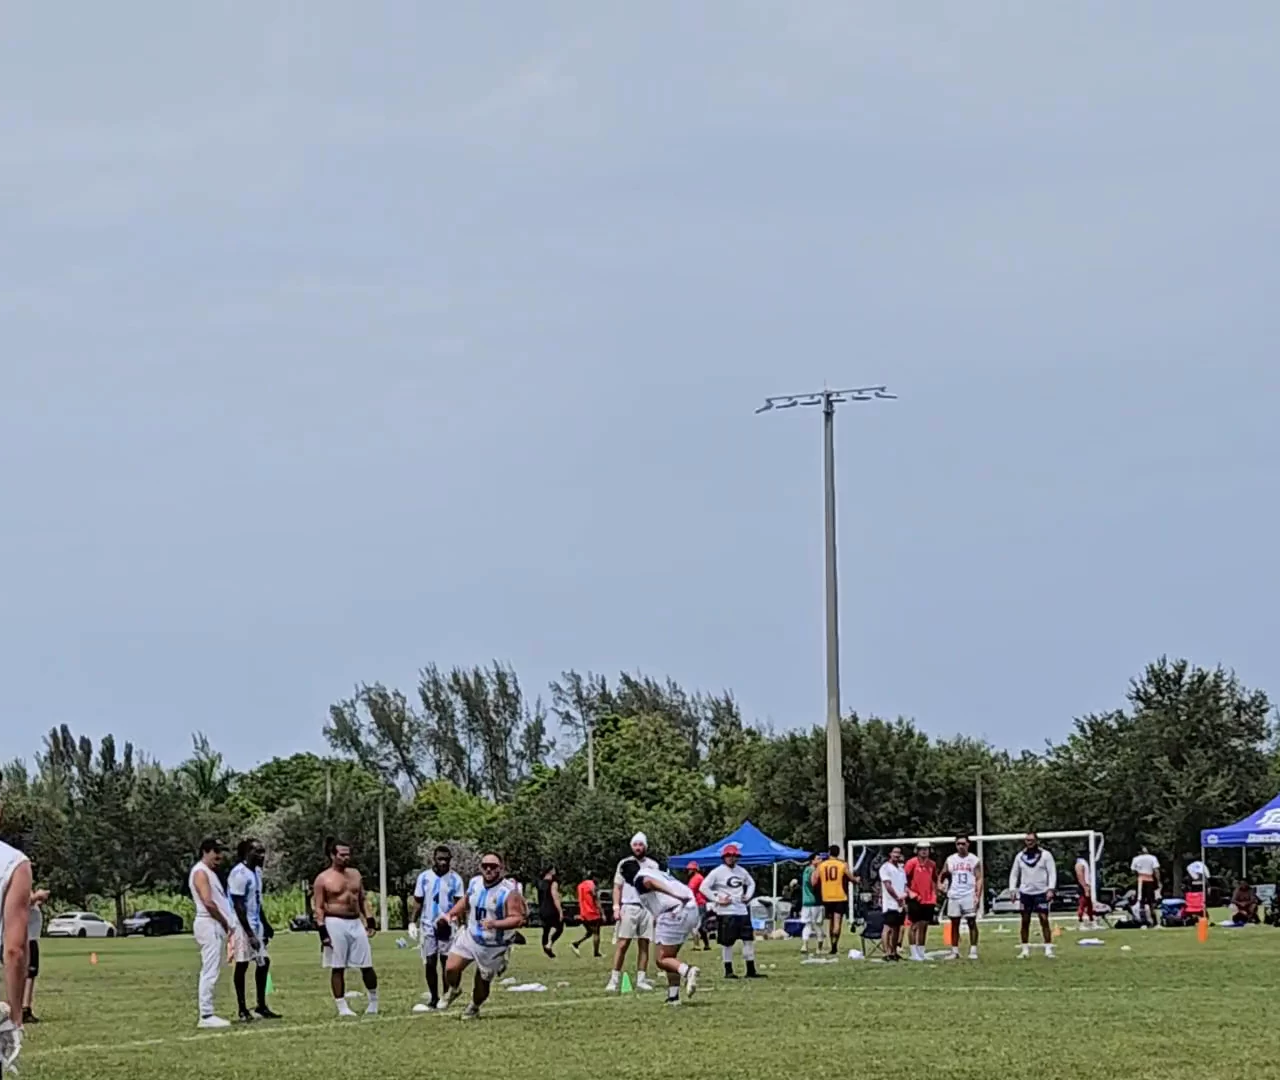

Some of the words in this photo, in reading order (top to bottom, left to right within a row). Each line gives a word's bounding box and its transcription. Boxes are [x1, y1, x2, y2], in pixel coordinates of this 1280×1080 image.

[824, 865, 838, 882] 10
[957, 873, 968, 884] 13
[726, 876, 743, 889] G
